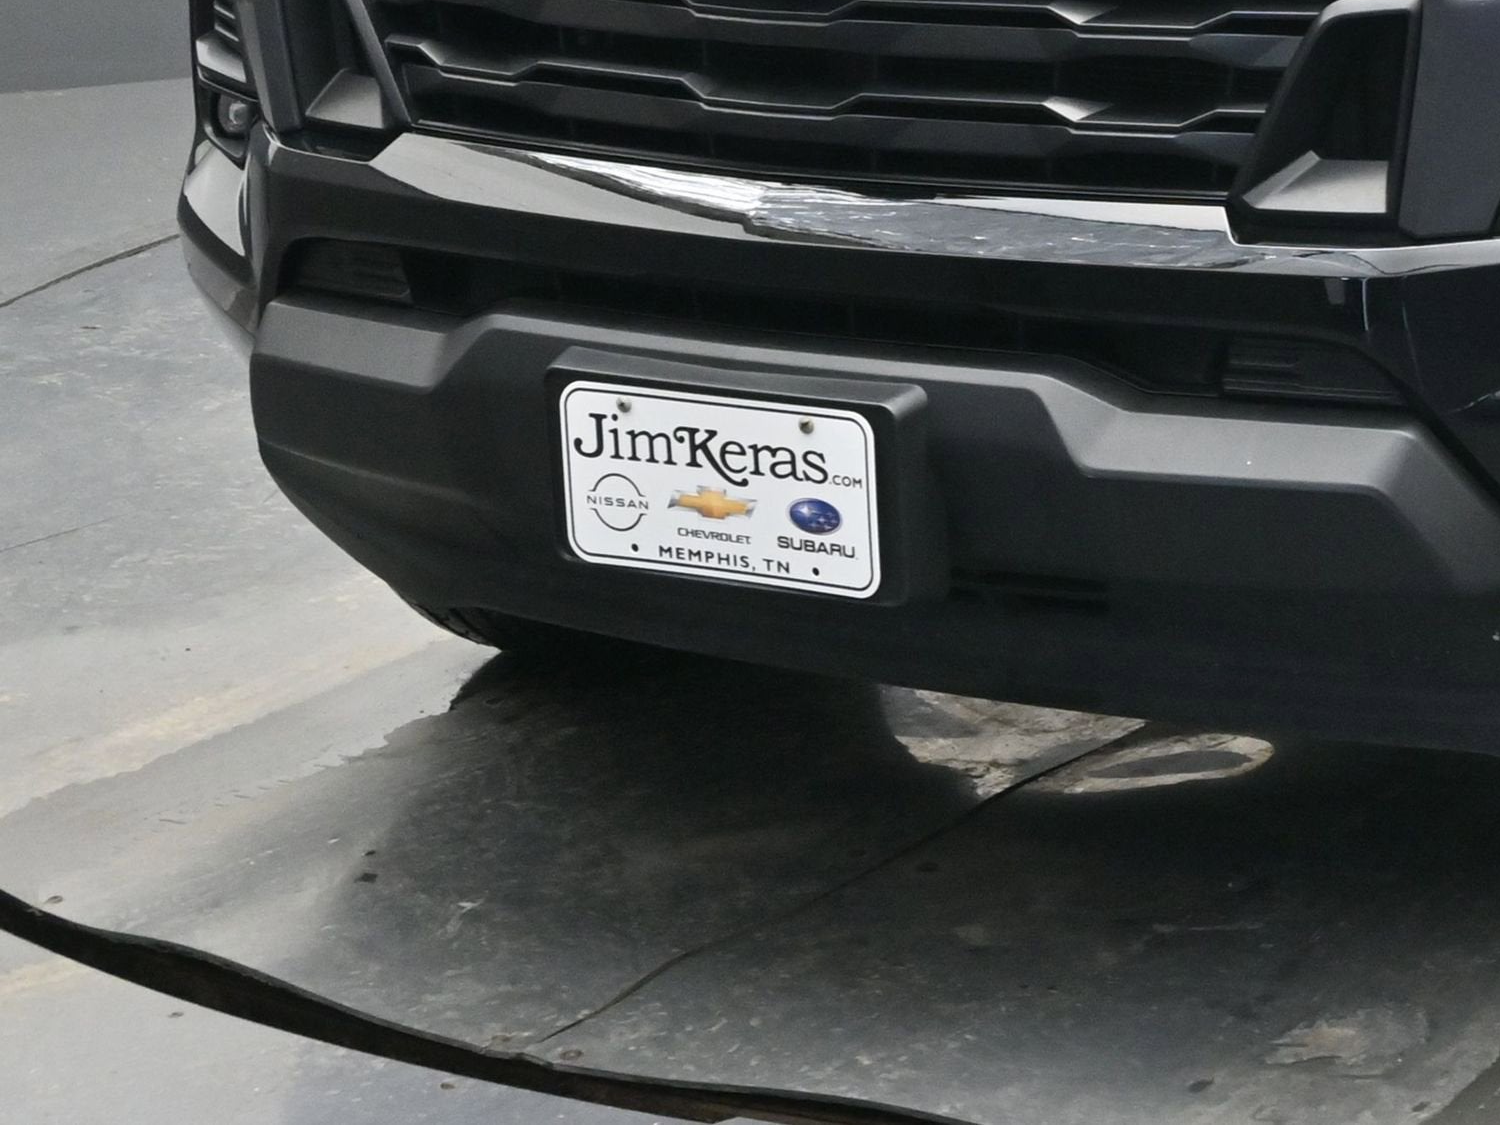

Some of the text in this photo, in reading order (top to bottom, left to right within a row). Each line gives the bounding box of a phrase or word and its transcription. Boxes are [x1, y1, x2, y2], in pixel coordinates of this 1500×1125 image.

[586, 494, 650, 511] NISSAN
[676, 526, 752, 545] CHEVROLET
[776, 535, 858, 560] SUBARU
[658, 545, 791, 575] MEMPHIS, TN
